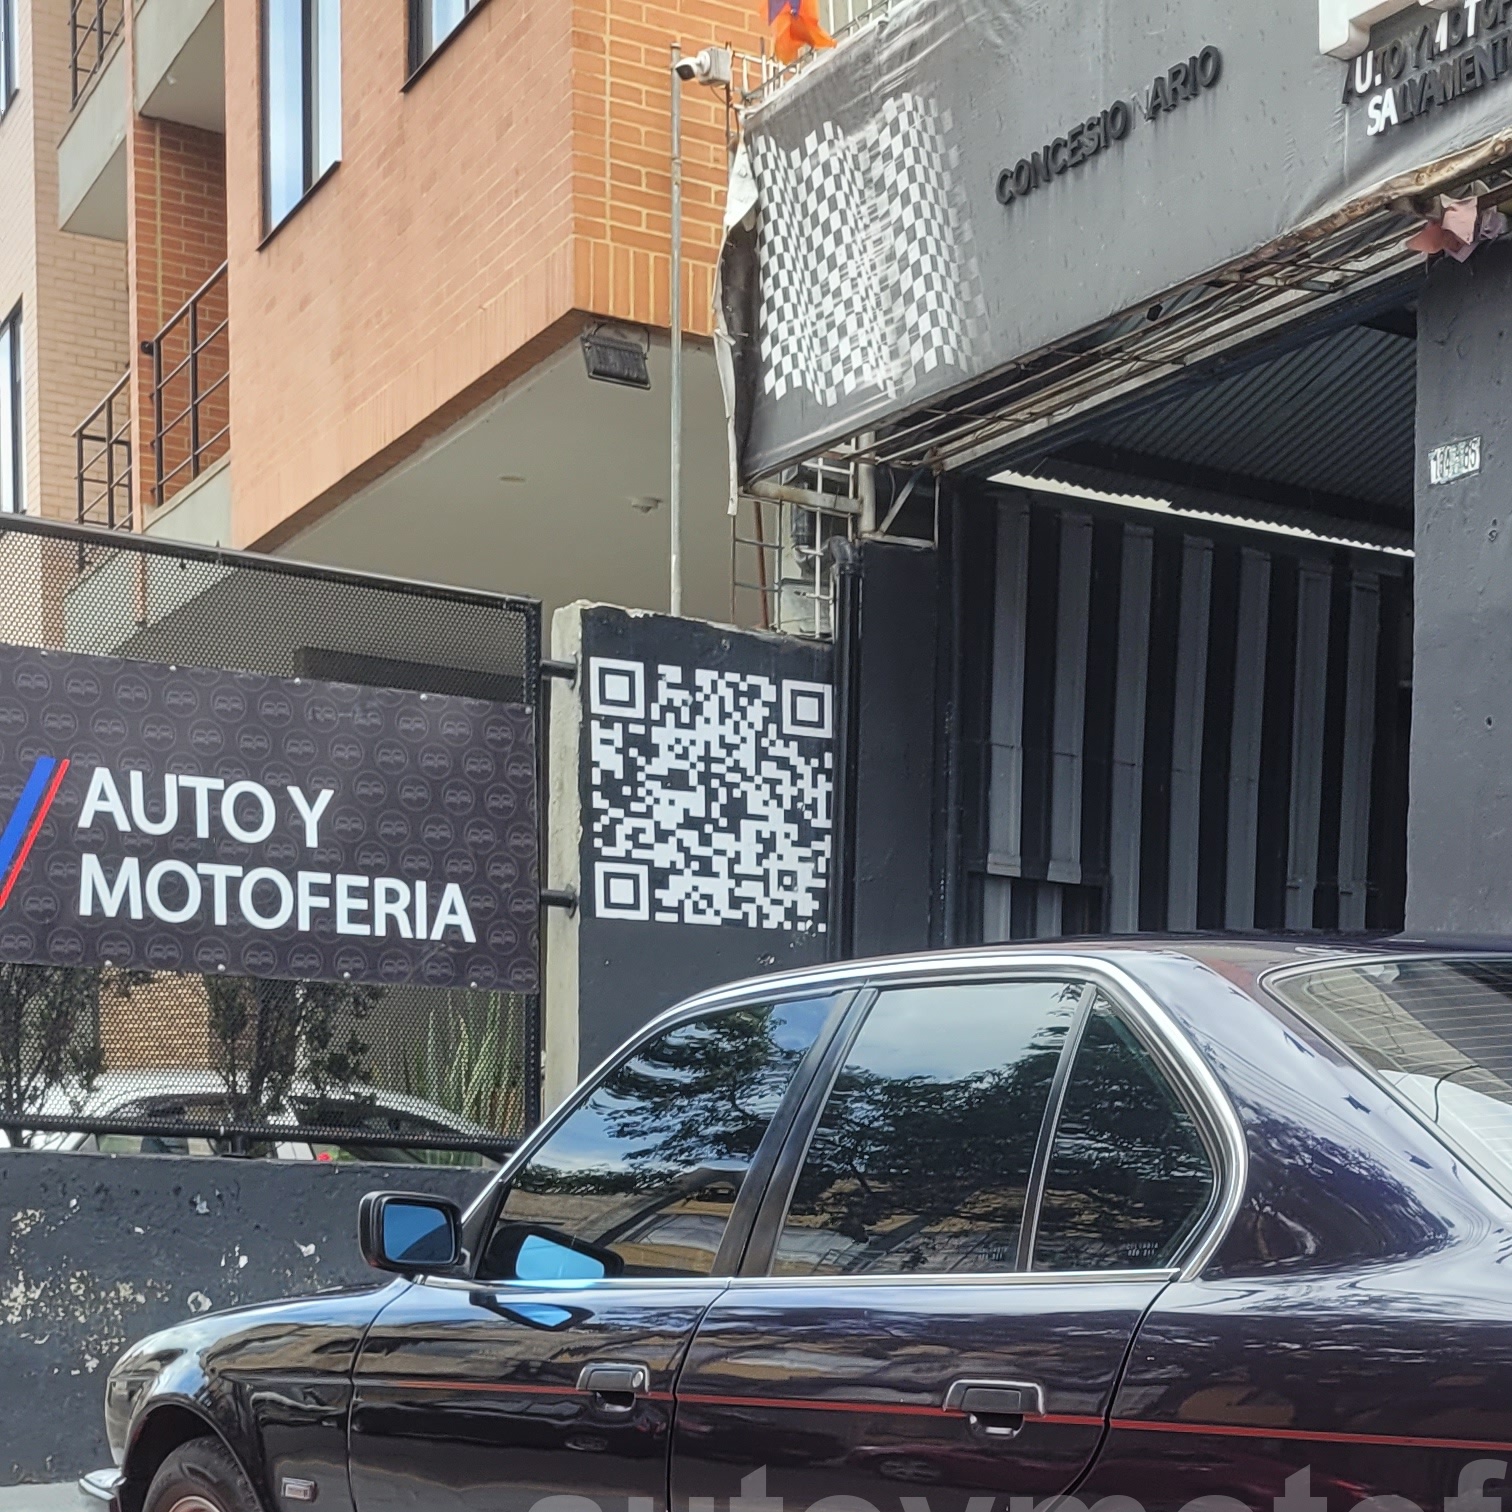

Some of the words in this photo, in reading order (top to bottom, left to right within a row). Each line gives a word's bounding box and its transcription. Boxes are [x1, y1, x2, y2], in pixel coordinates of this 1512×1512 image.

[996, 45, 1223, 206] CONCESIONARIO
[78, 766, 276, 844] AUTO
[287, 785, 335, 848] Y
[79, 853, 478, 943] MOTOFERIA
